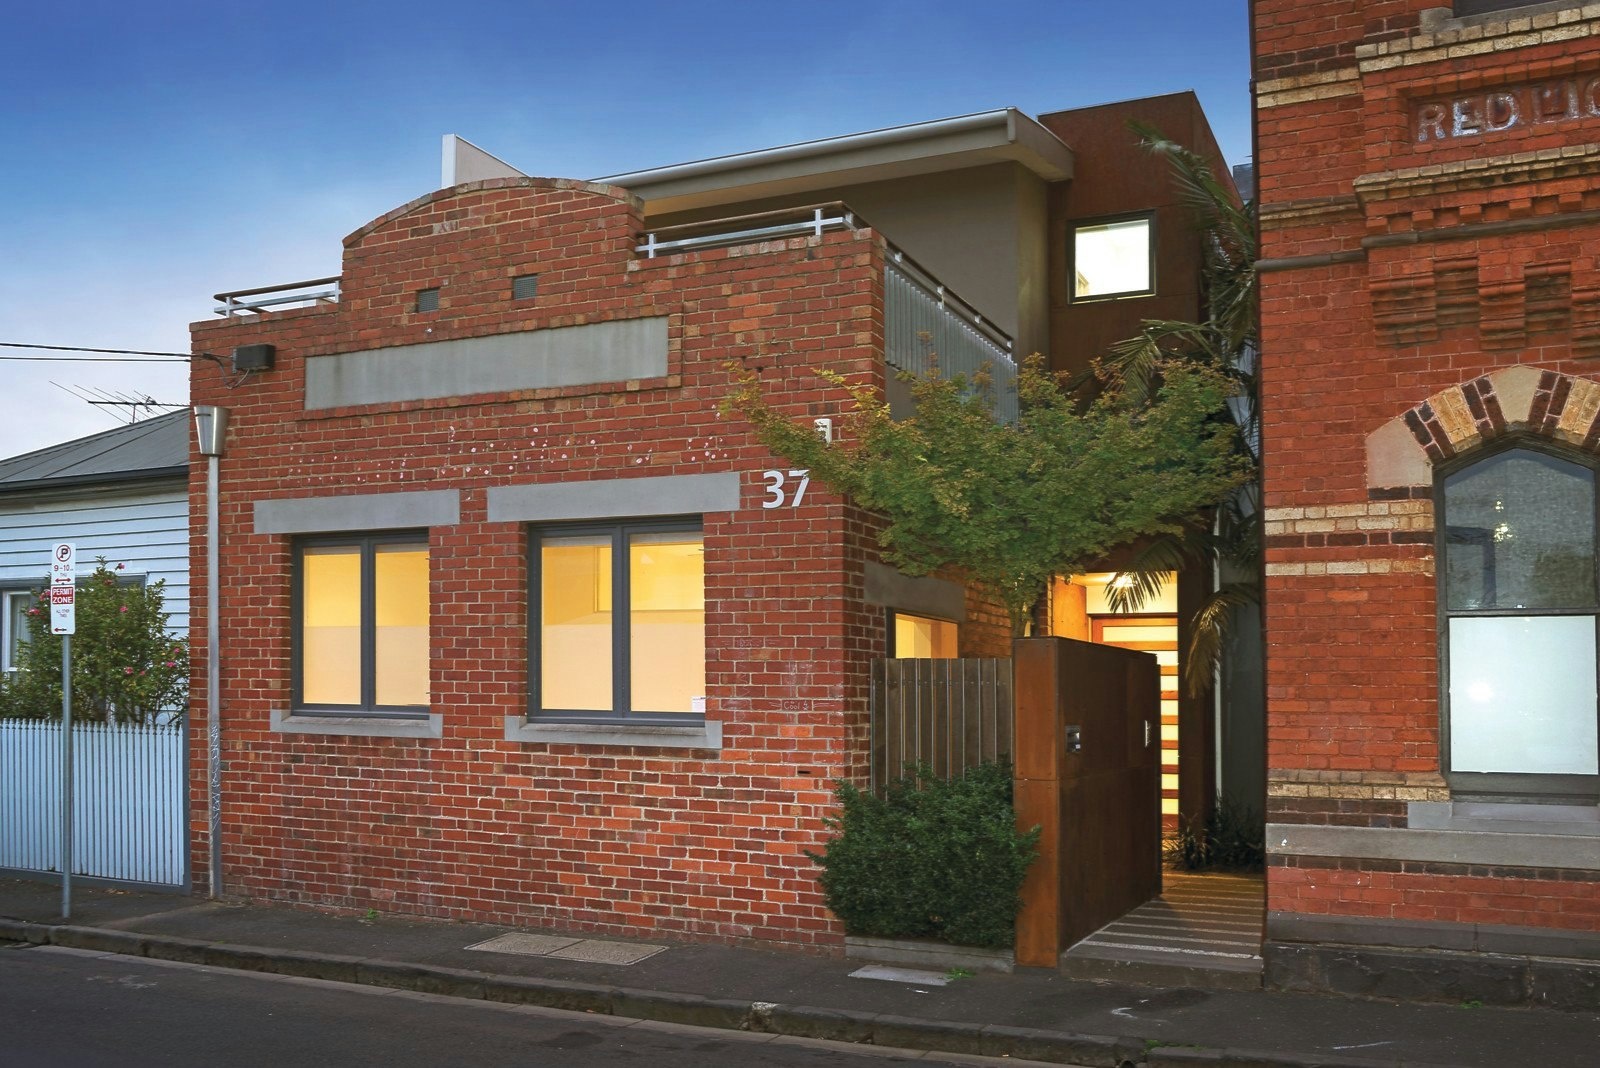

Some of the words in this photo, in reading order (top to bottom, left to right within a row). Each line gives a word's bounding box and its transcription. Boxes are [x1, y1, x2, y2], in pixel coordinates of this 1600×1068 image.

[762, 469, 810, 509] 37
[53, 587, 73, 595] PERMIT
[53, 596, 73, 604] ZONE
